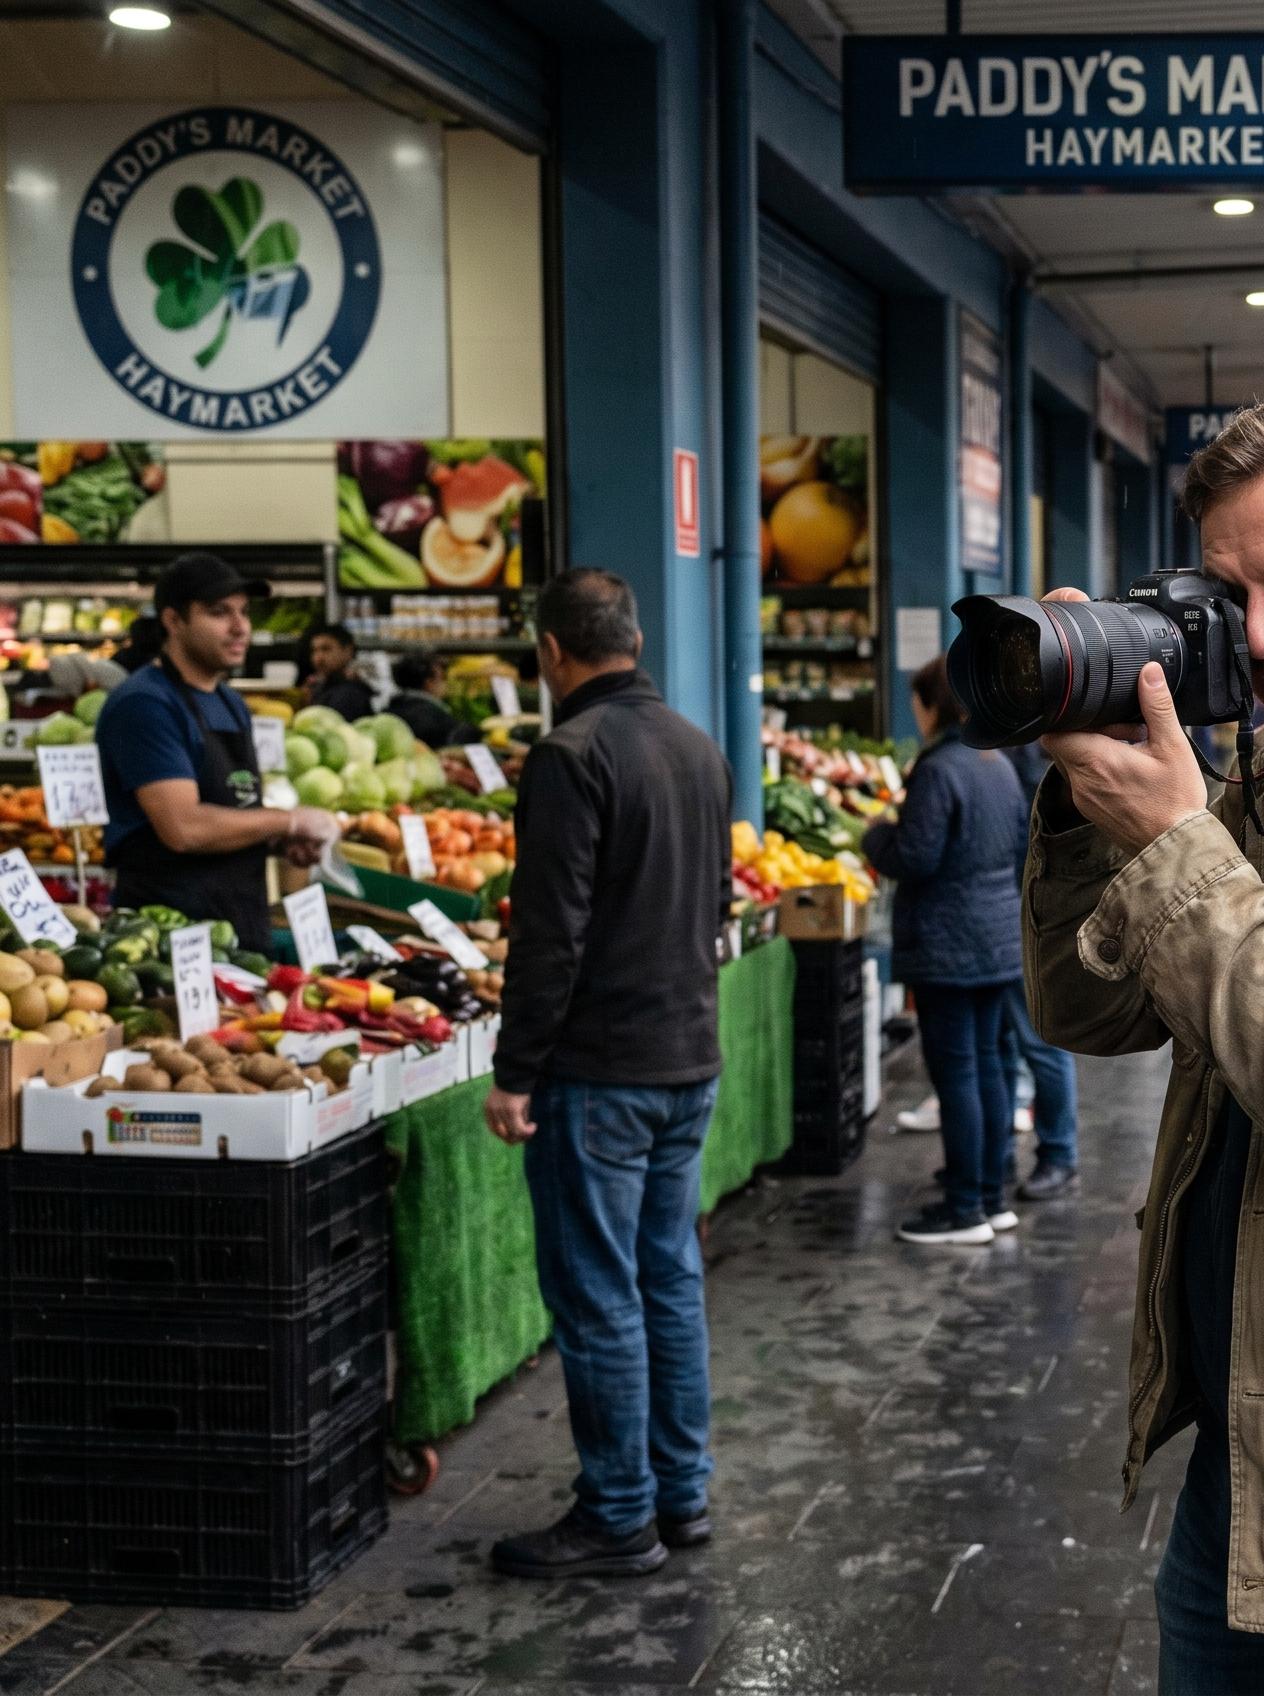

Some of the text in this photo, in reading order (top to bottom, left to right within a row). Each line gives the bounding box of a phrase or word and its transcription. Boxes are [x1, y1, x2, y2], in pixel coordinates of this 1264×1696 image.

[899, 51, 1147, 117] PADDY'S
[86, 116, 365, 226] PADDY'S MARKET
[115, 345, 342, 428] HAYMARKET
